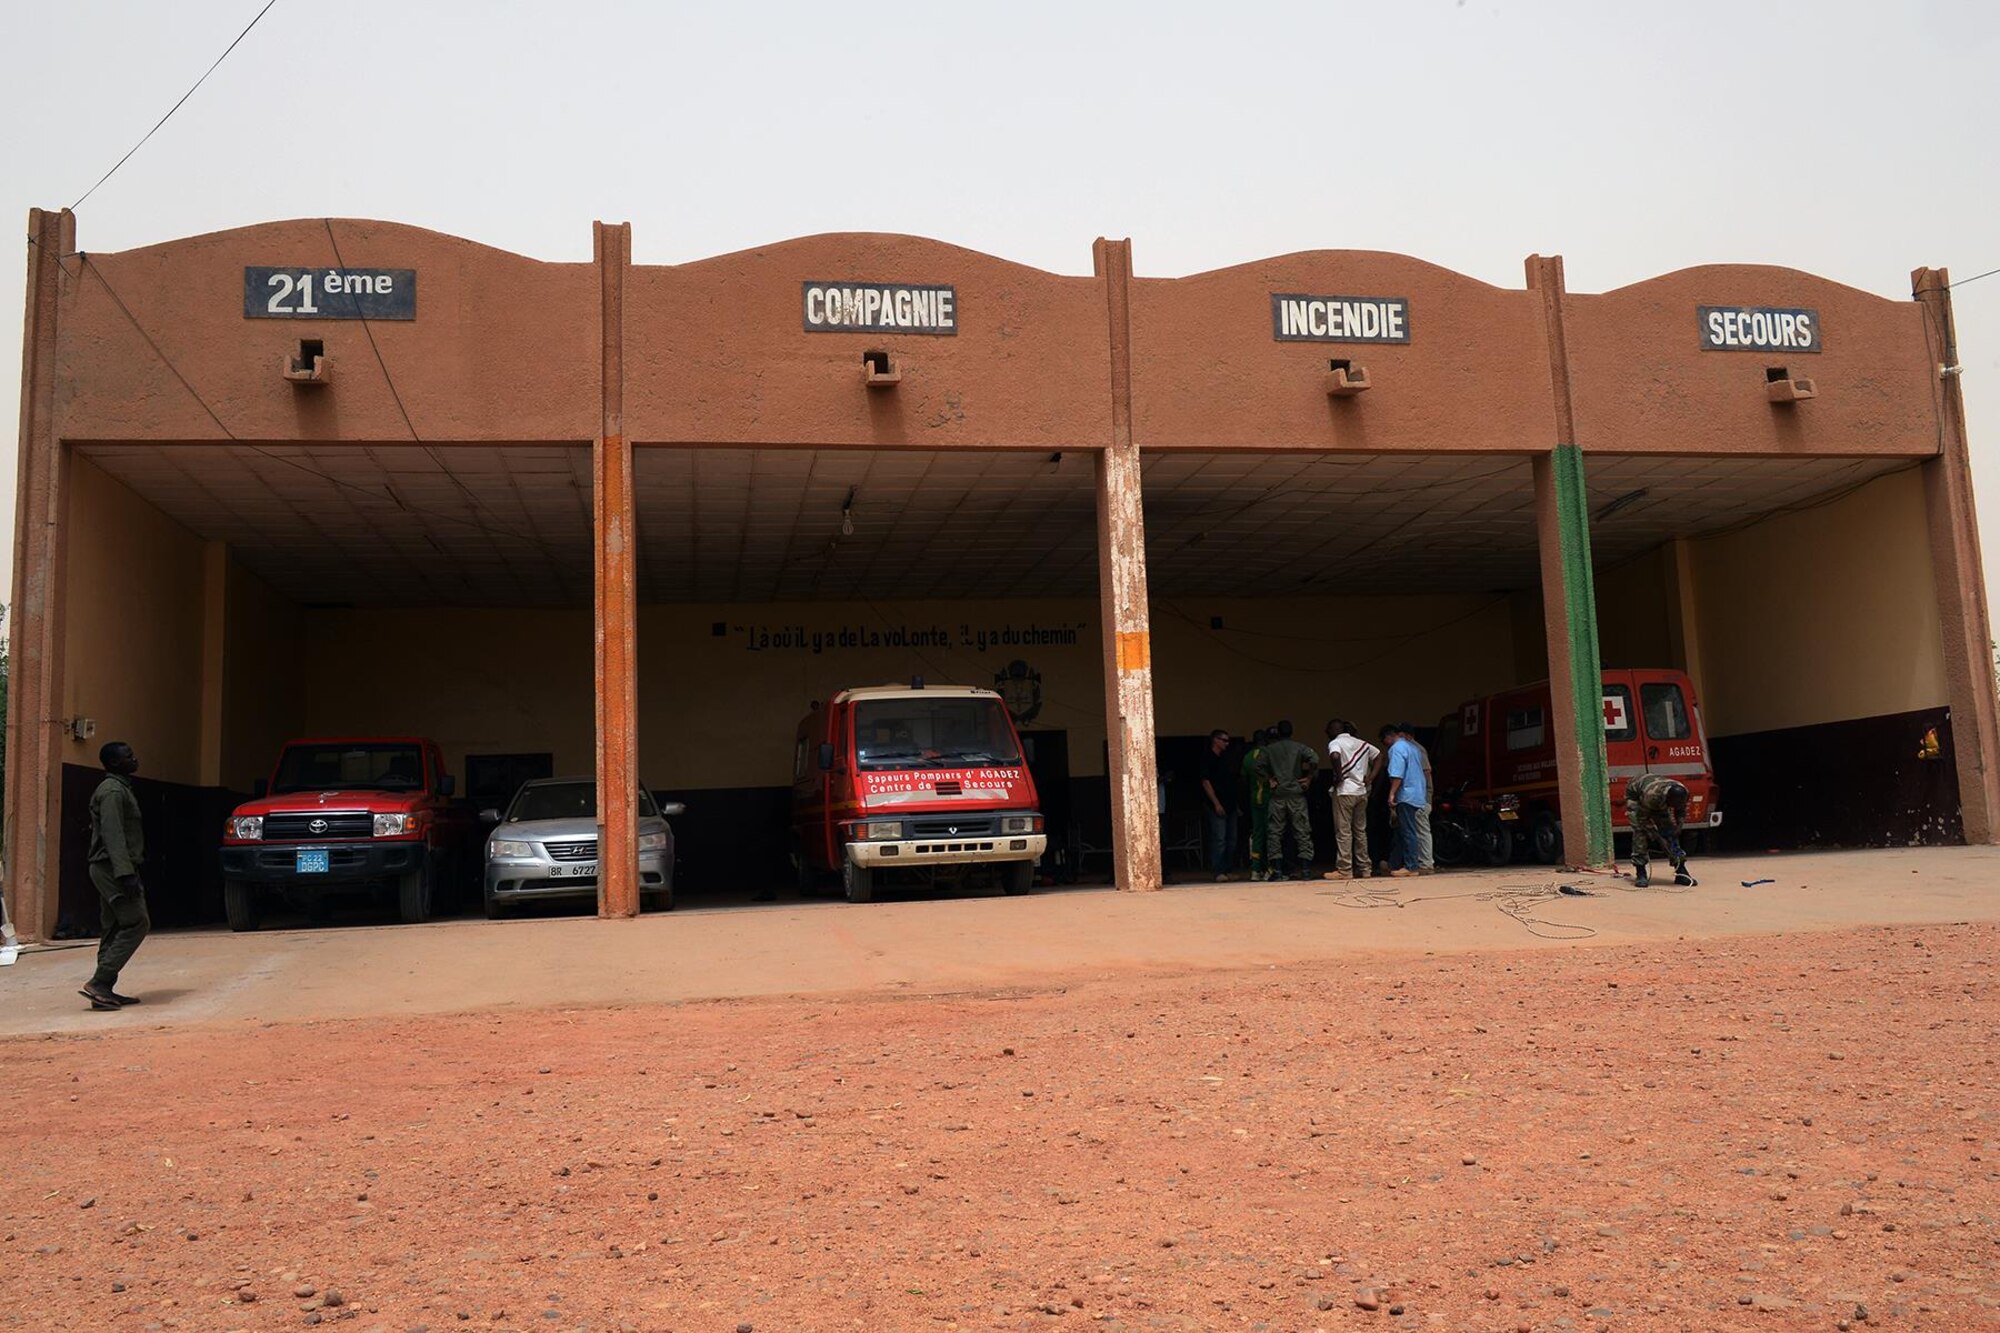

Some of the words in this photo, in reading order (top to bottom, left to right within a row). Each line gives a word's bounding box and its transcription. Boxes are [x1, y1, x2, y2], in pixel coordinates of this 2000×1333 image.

[268, 273, 318, 313] 21
[324, 270, 393, 294] ème
[807, 287, 954, 327] COMPAGNIE
[1280, 300, 1404, 338] INCENDIE
[1708, 311, 1812, 348] SECOURS
[978, 631, 986, 652] y
[990, 631, 998, 645] a
[1669, 746, 1701, 757] AGADEZ
[867, 772, 910, 784] Sapeurs
[914, 771, 961, 782] Pompiers
[980, 770, 1020, 779] AGADEZ
[870, 783, 912, 794] Centre
[918, 782, 932, 790] de
[964, 780, 1013, 789] Secours
[572, 865, 596, 875] 6727
